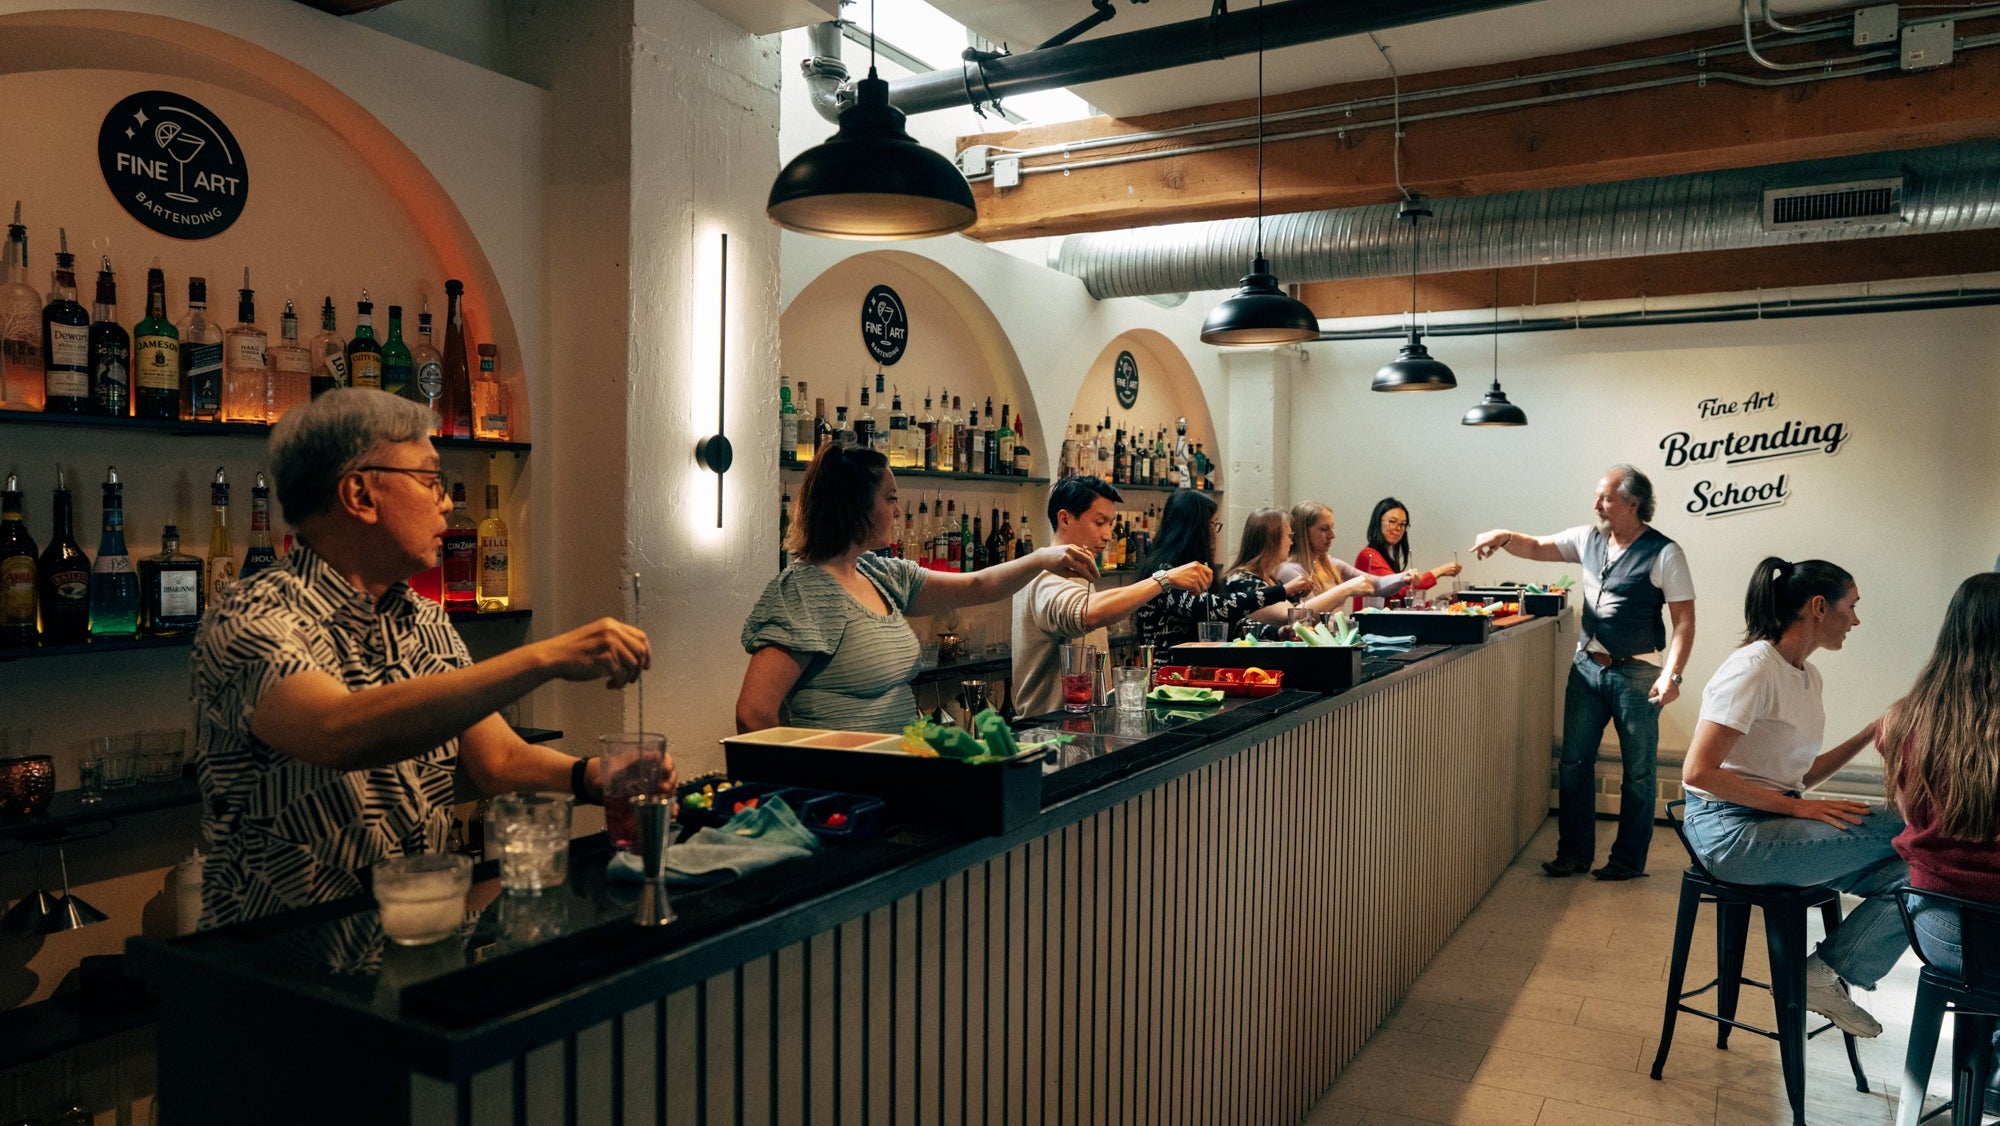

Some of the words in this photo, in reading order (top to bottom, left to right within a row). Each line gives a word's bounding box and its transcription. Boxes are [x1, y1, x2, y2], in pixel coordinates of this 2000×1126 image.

[117, 152, 169, 182] FINE
[193, 171, 240, 196] ART
[135, 191, 223, 225] BARTENDING
[54, 330, 87, 342] Dewar
[865, 321, 883, 335] FINE
[889, 327, 905, 339] ART
[138, 340, 178, 353] JAMESON
[1698, 398, 1738, 419] Fine
[1743, 391, 1775, 413] Art
[1659, 421, 1849, 467] Bartending
[1686, 474, 1787, 514] School
